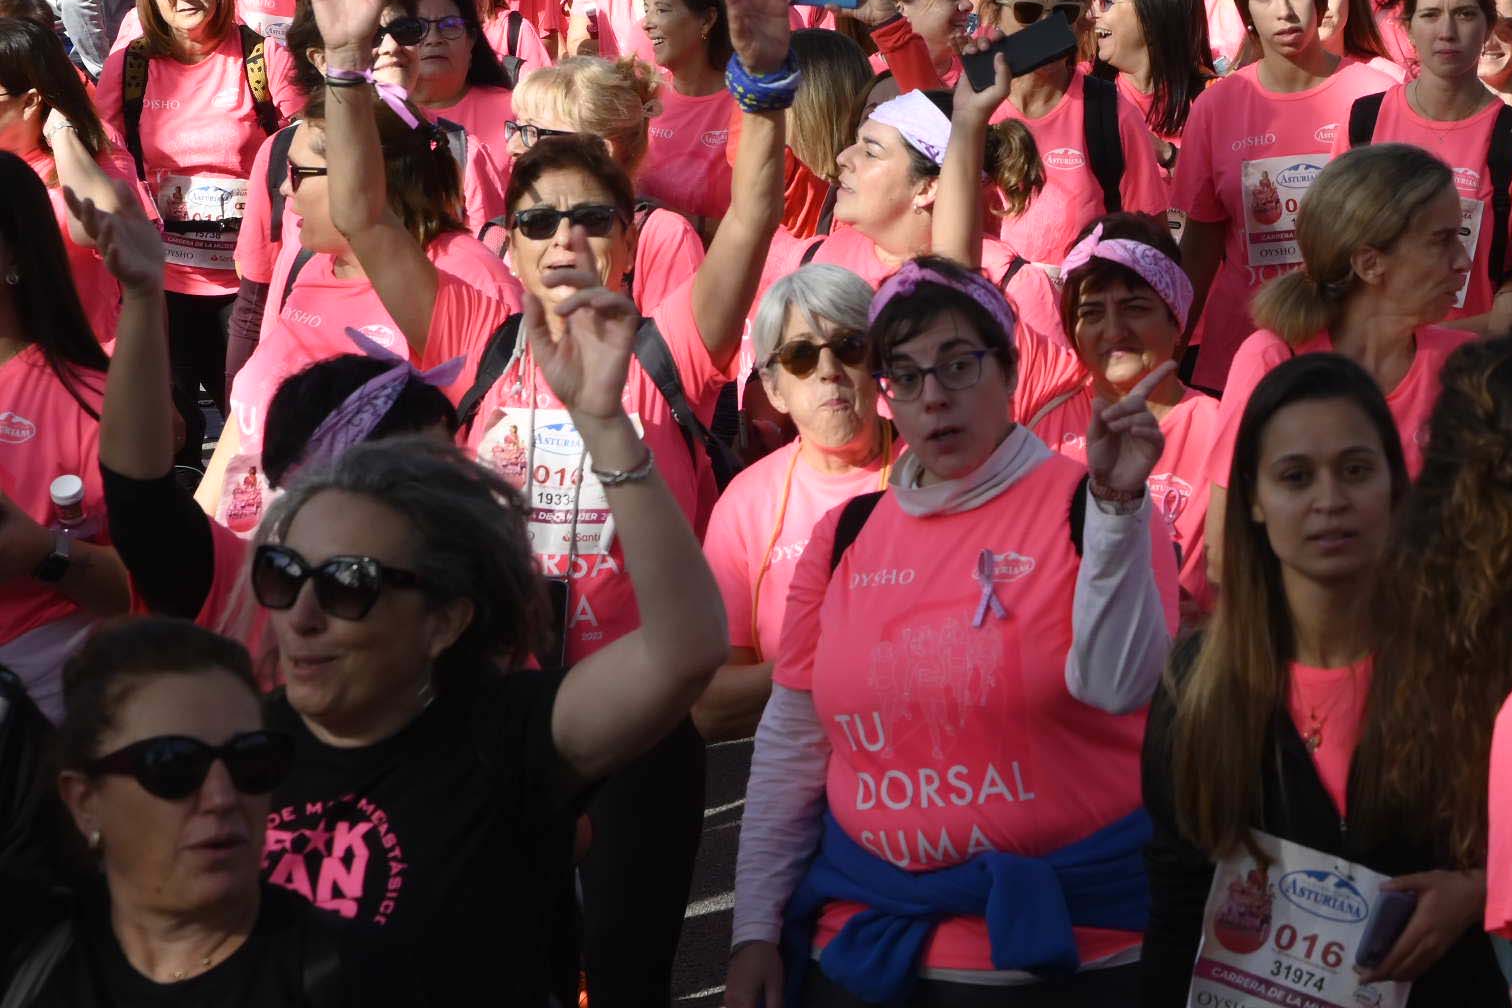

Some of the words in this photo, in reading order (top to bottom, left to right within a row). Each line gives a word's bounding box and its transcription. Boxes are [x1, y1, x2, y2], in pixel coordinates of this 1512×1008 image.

[648, 127, 674, 139] SHO
[1231, 132, 1277, 151] OYSHO
[1280, 174, 1317, 184] ASTURIA
[1260, 248, 1296, 258] OYSHO
[834, 711, 885, 753] TU
[855, 760, 1036, 811] DORSAL
[262, 852, 364, 904] AN
[1286, 879, 1361, 919] ASTURIANA
[1274, 924, 1346, 969] 016
[1211, 966, 1266, 993] CARRERA
[1270, 959, 1326, 992] 31974
